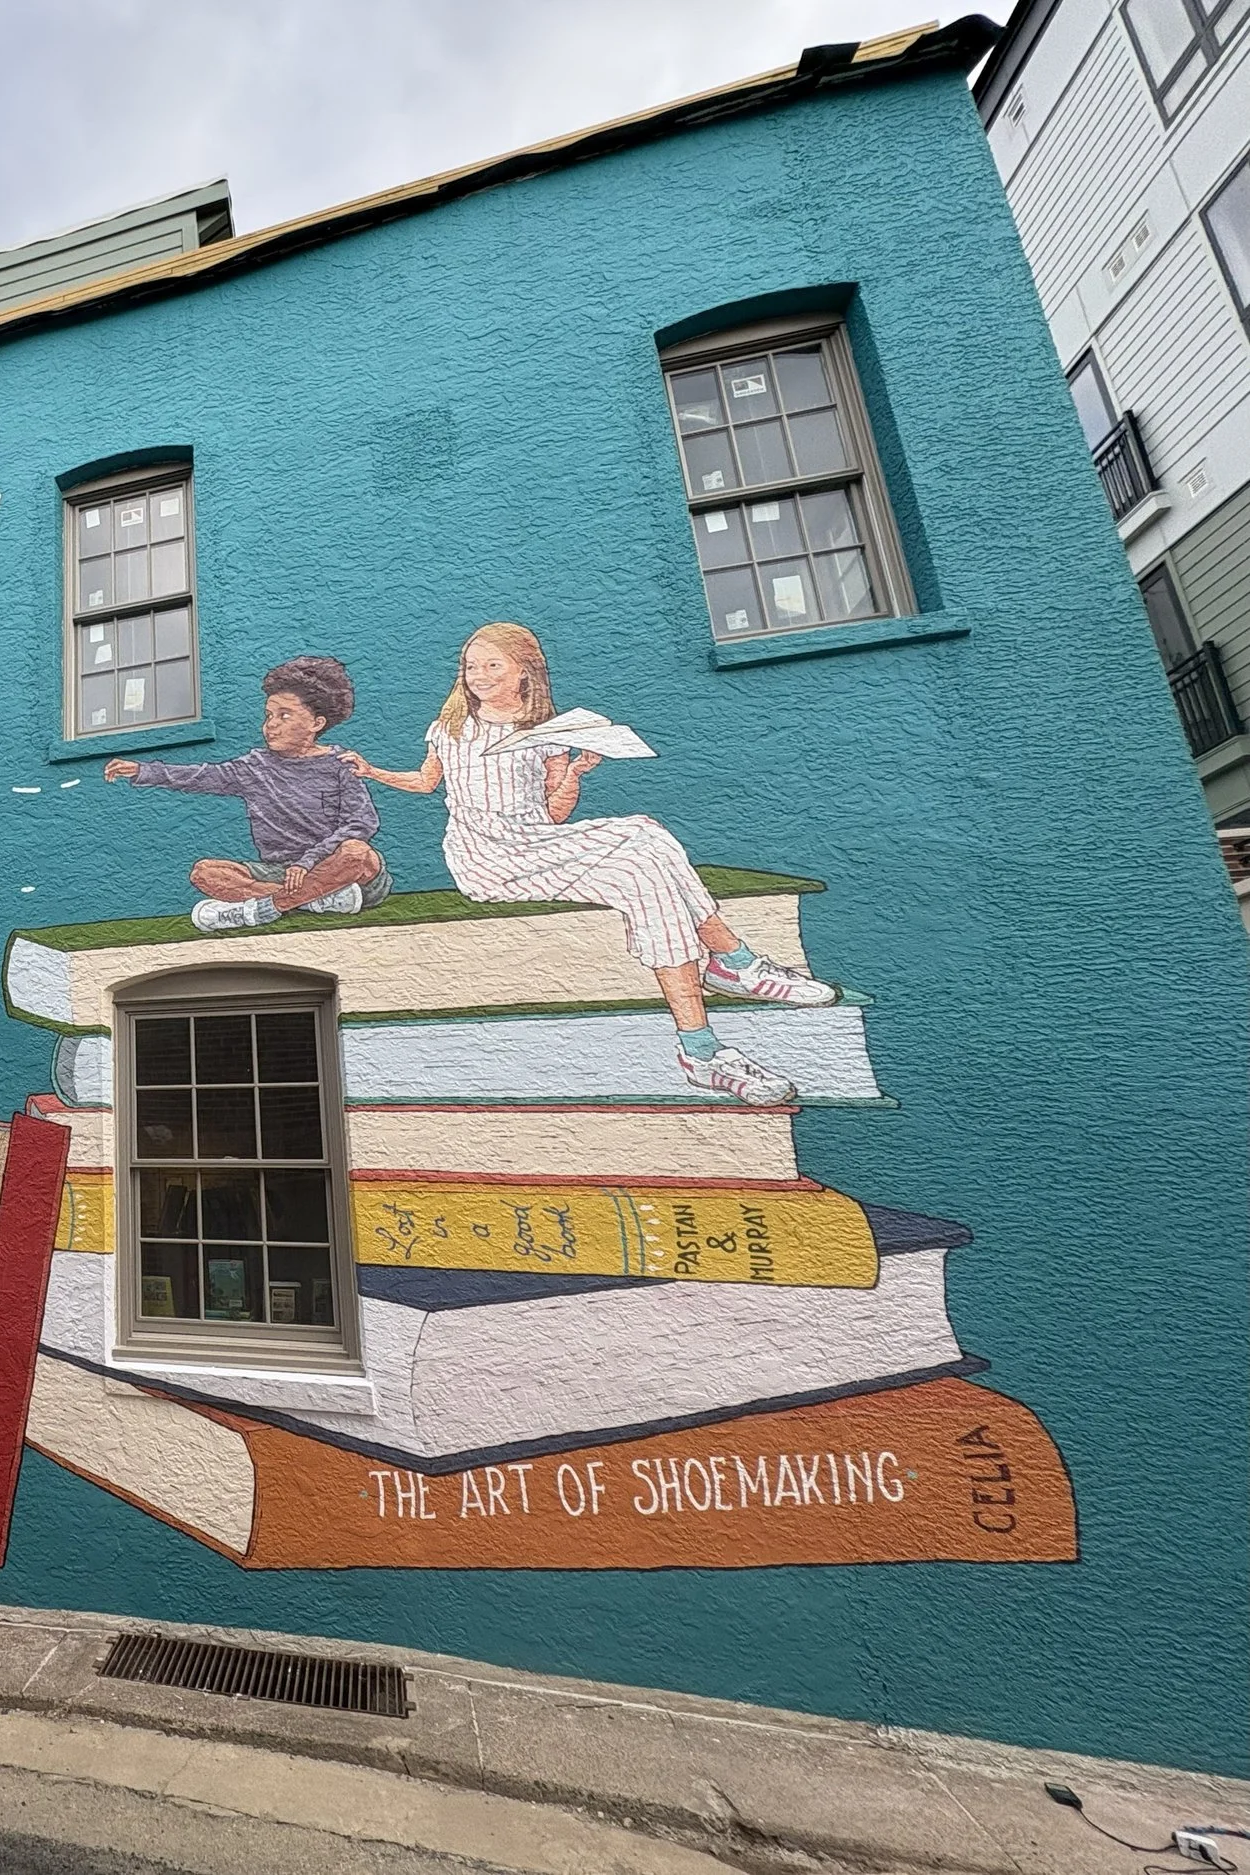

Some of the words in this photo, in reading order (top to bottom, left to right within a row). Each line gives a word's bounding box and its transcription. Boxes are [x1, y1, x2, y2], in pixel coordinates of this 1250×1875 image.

[375, 1201, 419, 1260] Lost
[472, 1222, 491, 1238] a
[500, 1200, 552, 1262] good
[541, 1200, 577, 1259] book
[672, 1204, 700, 1274] PASTAN
[706, 1231, 737, 1253] &
[740, 1203, 774, 1281] MURRAY
[368, 1471, 437, 1520] THE
[459, 1464, 534, 1518] ART
[557, 1462, 606, 1517] OF
[631, 1451, 905, 1516] SHOEMAKING
[956, 1425, 1017, 1534] CELIA
